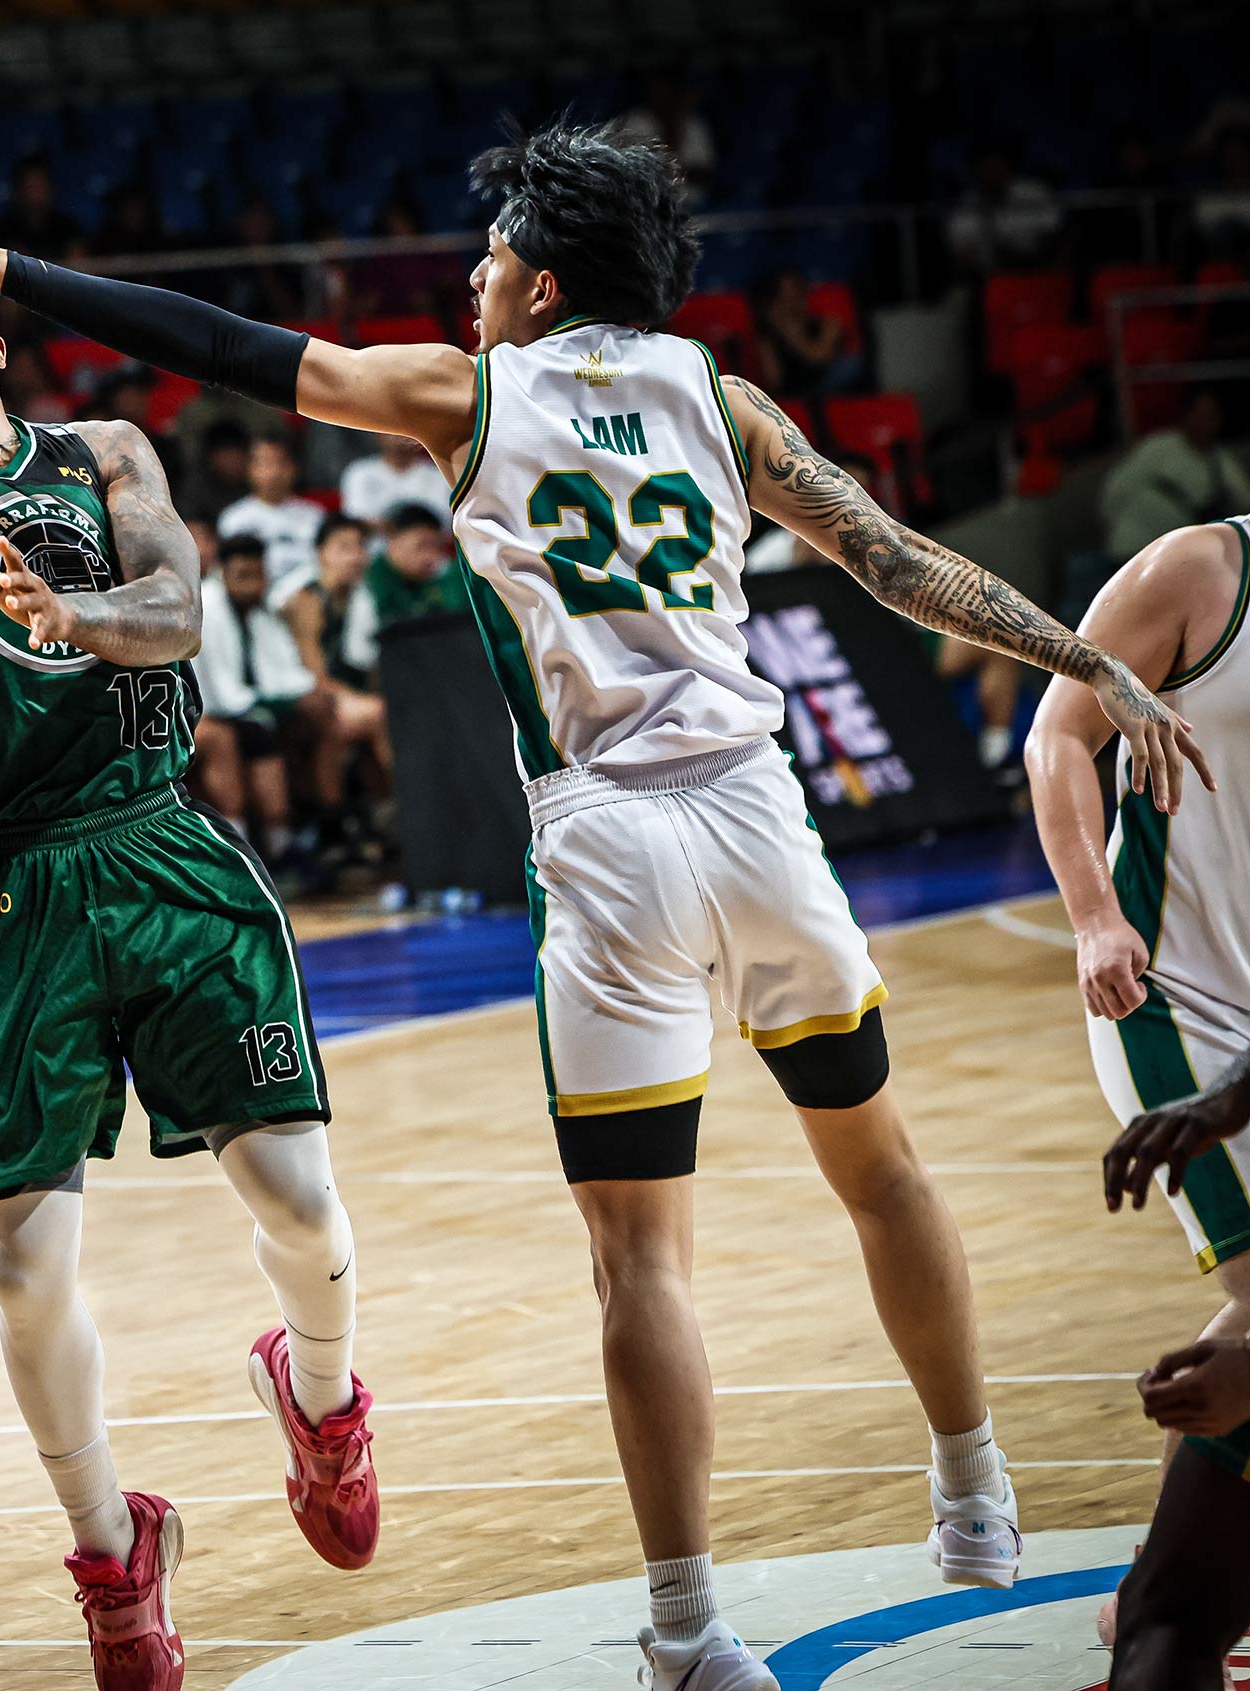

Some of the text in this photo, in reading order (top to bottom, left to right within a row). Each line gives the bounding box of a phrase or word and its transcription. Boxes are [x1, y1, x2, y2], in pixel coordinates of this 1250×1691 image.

[571, 412, 648, 456] LAM
[526, 470, 716, 618] 22
[106, 669, 180, 750] 13
[239, 1021, 302, 1086] 13
